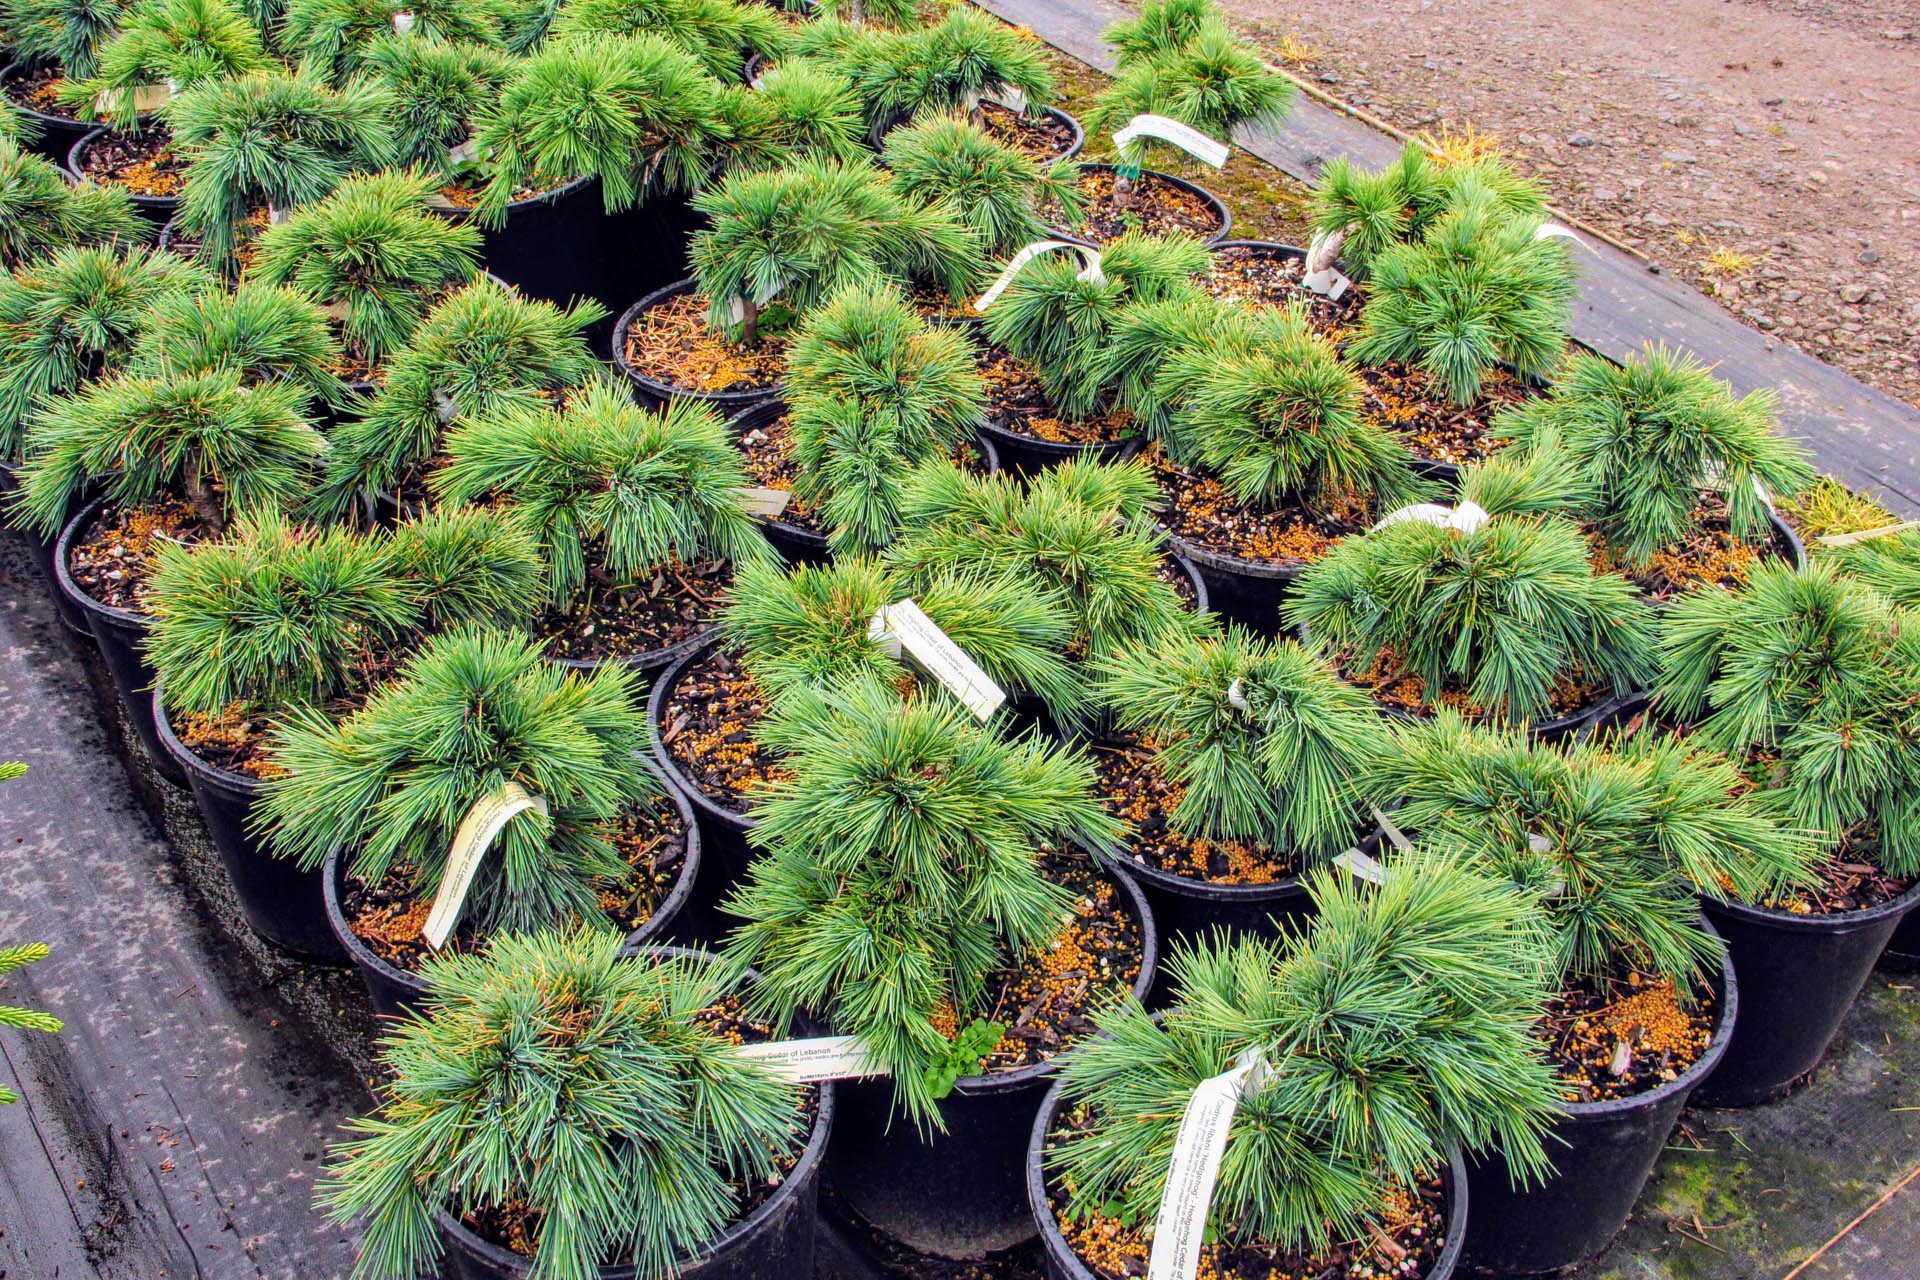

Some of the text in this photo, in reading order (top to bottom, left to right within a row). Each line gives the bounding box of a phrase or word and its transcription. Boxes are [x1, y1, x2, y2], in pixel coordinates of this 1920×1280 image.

[790, 1049, 798, 1057] of
[800, 1047, 831, 1057] Lebanon
[1210, 1100, 1225, 1126] Cedrus
[1204, 1128, 1216, 1151] libani
[1191, 1153, 1209, 1199] 'Hedgehog'
[1181, 1205, 1196, 1246] Hedgehog
[1178, 1247, 1188, 1270] Cedar
